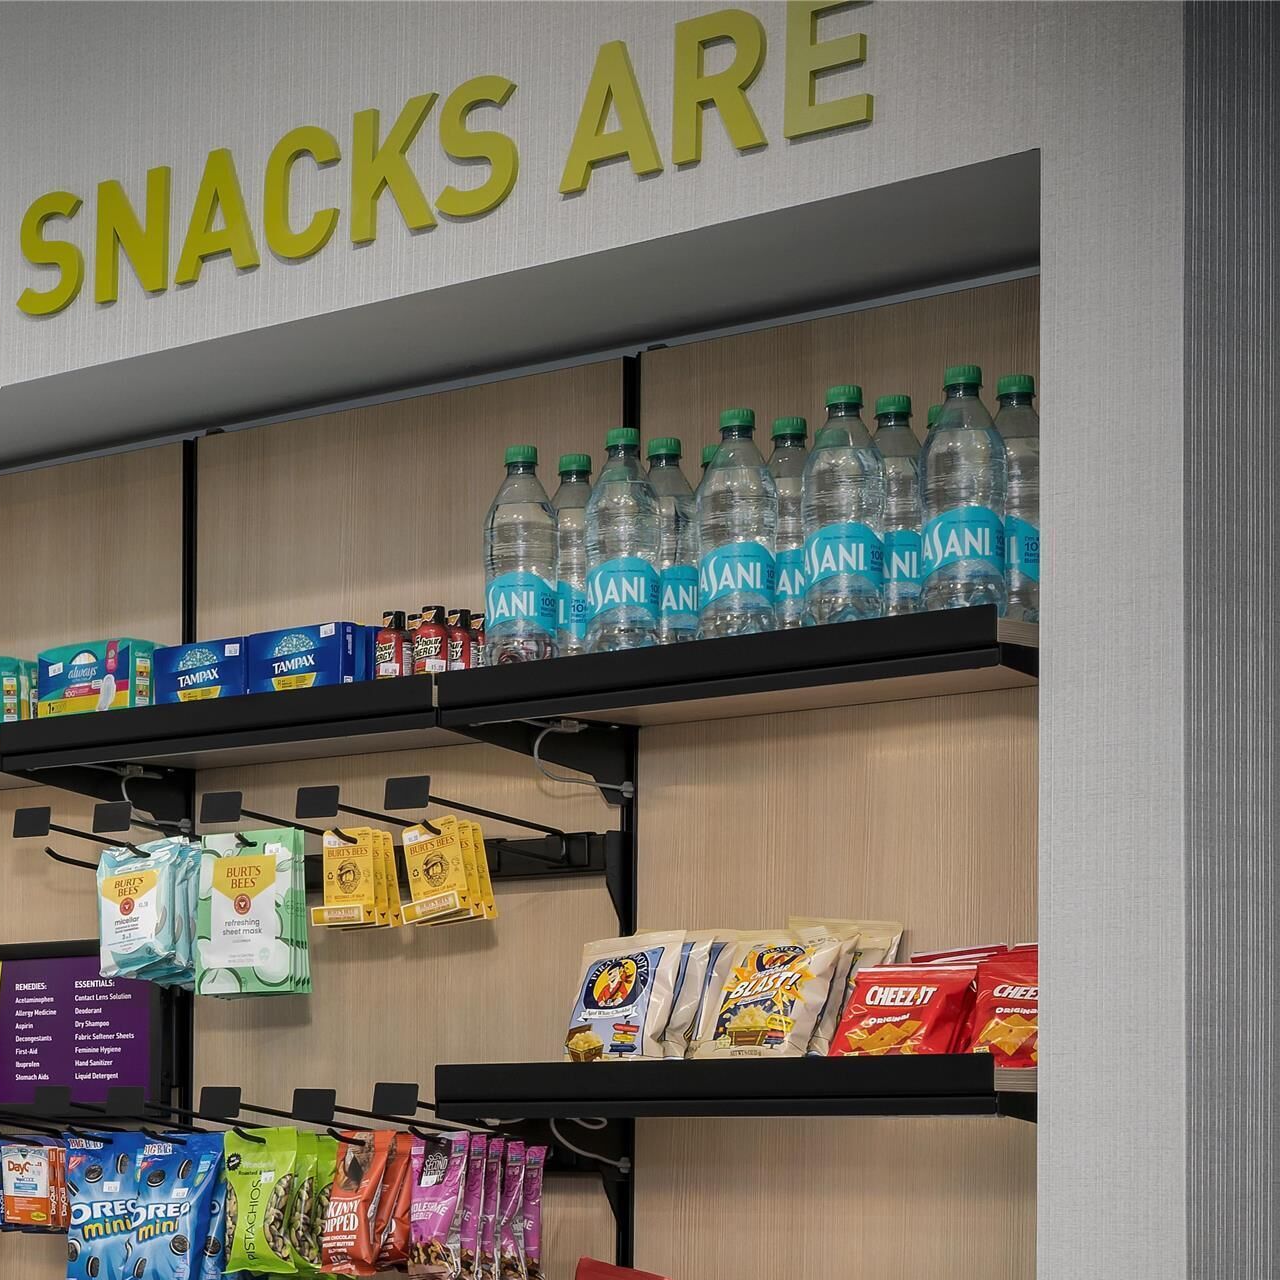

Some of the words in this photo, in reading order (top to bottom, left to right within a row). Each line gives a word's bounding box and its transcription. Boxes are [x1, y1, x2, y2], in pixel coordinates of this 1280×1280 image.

[16, 74, 519, 317] SNACKS
[558, 0, 875, 196] ARE
[68, 665, 99, 681] always
[178, 666, 220, 688] TAMPAX
[226, 865, 261, 878] BURT'S
[231, 877, 257, 889] BEES
[224, 918, 260, 928] refreshing
[222, 928, 241, 936] sheet
[242, 927, 263, 935] mask
[74, 979, 115, 989] ESSENTIALS:
[15, 996, 54, 1004] Acetaminophen
[74, 994, 95, 1002] Contact
[15, 1010, 33, 1018] Allergy
[74, 1007, 102, 1015] Deodorant
[74, 1021, 84, 1029] Dry
[15, 1035, 52, 1043] Decongestants
[74, 1073, 91, 1081] Liquid
[92, 1072, 118, 1081] Detergent
[244, 1179, 263, 1261] PISTACHIOS
[138, 1218, 179, 1241] mini
